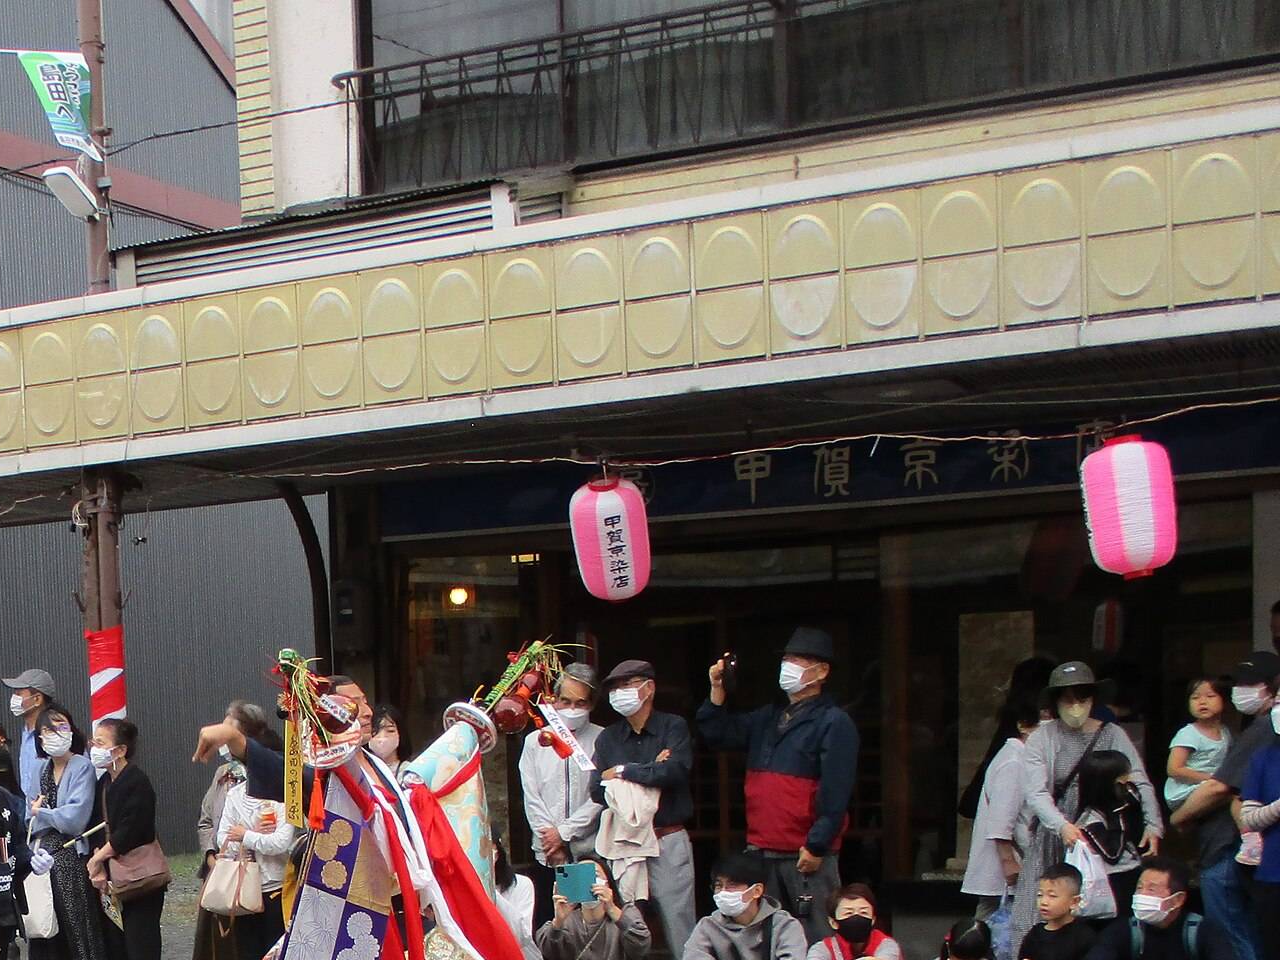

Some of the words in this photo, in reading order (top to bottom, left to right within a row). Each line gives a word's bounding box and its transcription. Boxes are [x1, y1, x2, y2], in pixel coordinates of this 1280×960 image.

[604, 514, 630, 589] 甲賀京染店
